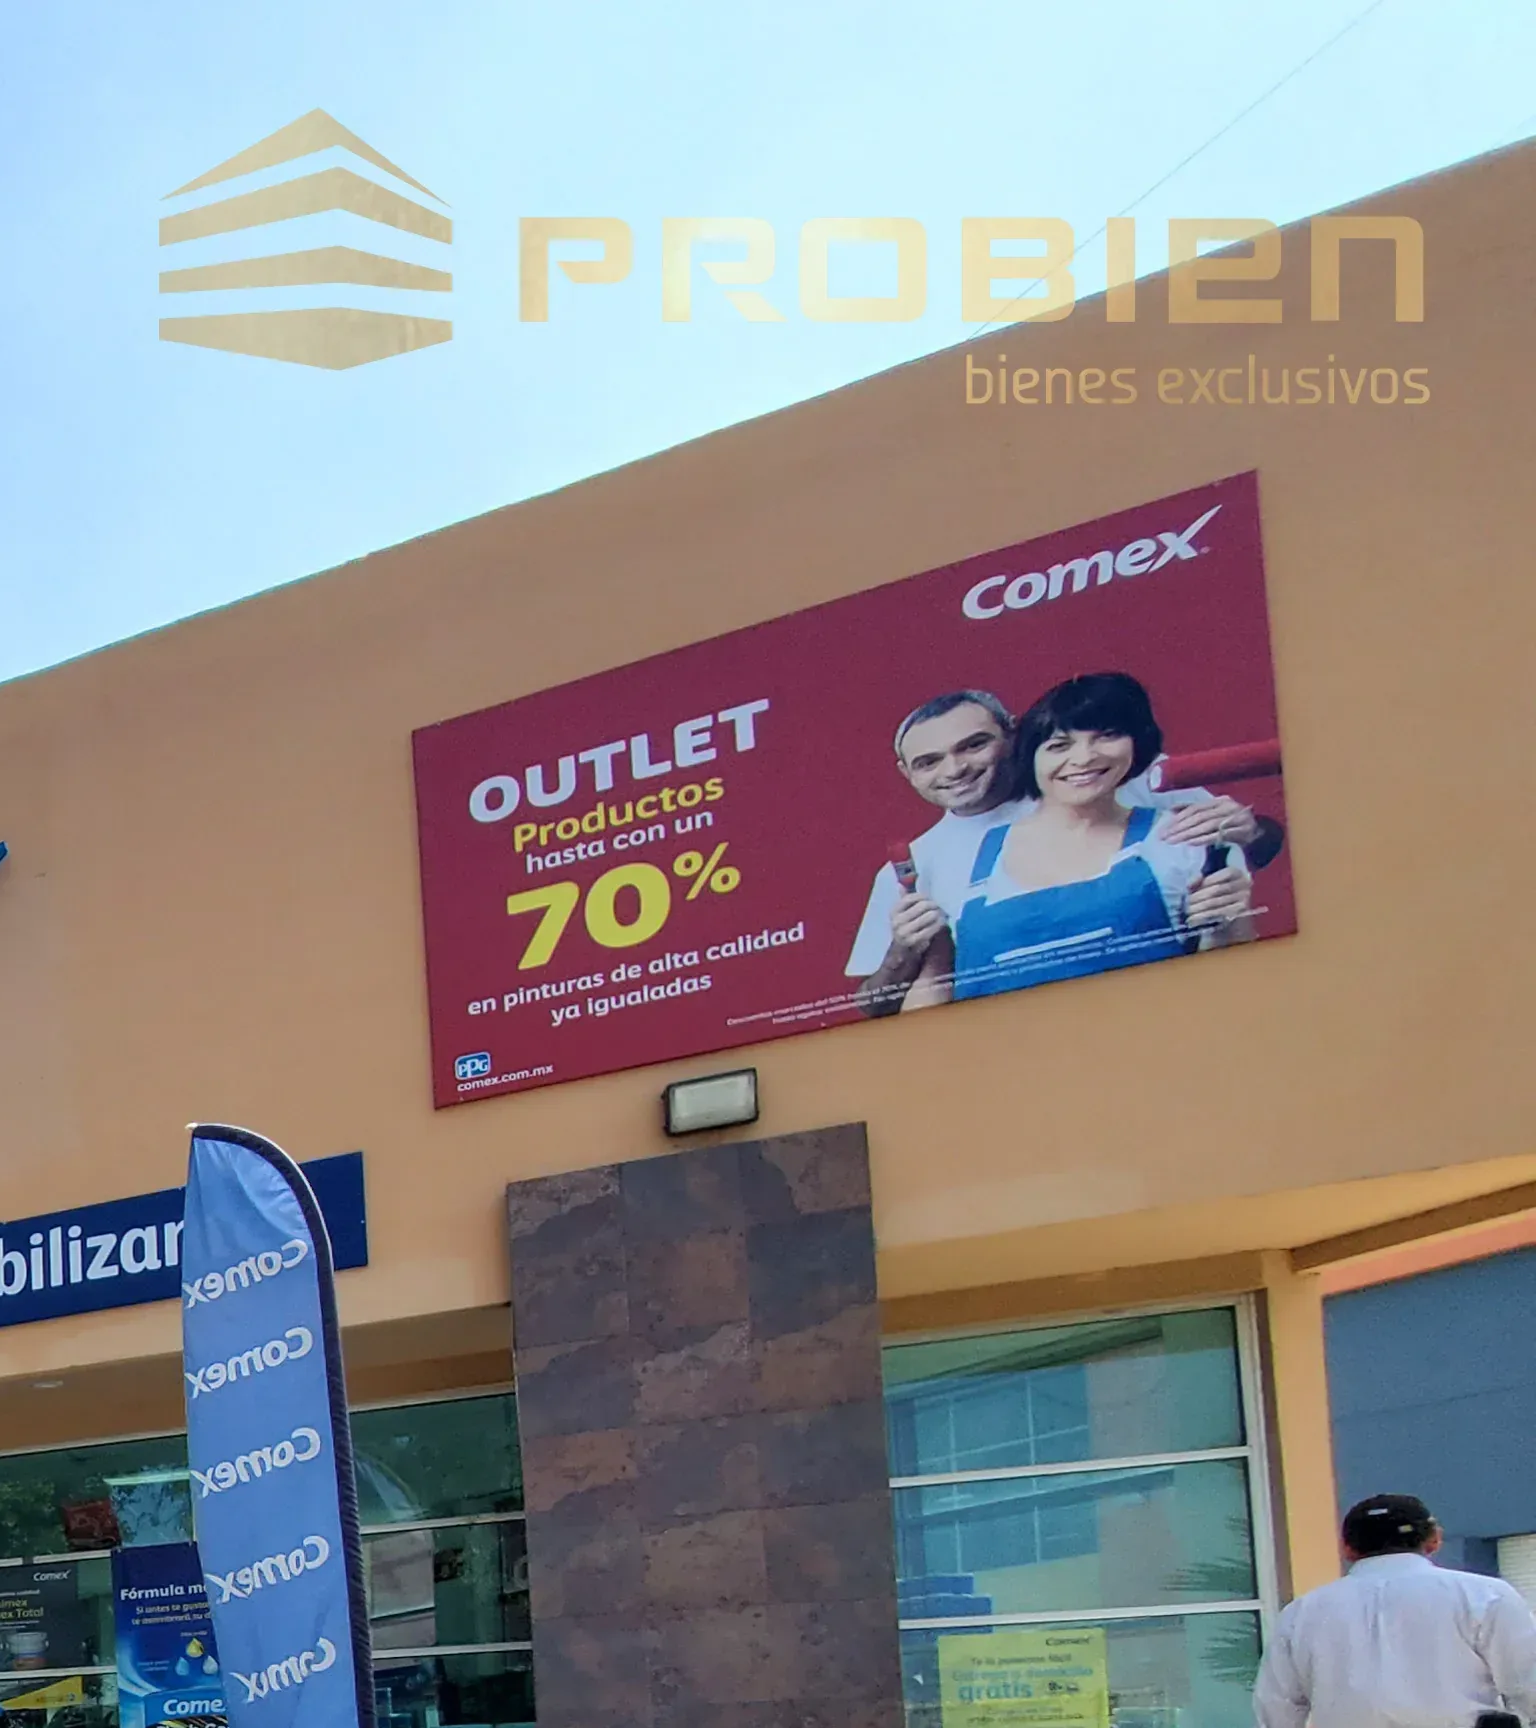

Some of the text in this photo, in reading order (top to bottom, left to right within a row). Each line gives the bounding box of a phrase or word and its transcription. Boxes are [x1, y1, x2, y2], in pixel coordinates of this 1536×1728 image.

[962, 504, 1222, 619] Comex
[469, 698, 769, 823] OUTLET
[513, 777, 724, 852] Productos
[526, 810, 713, 873] hasta con un
[507, 842, 741, 971] 70%
[467, 921, 804, 1015] en pinturas de alta calidad
[550, 972, 713, 1027] ya igualadas
[456, 1056, 490, 1079] PPG
[457, 1064, 554, 1092] comex.com.mx
[33, 1569, 71, 1581] Comex
[120, 1584, 185, 1600] Fórmula
[163, 1699, 227, 1716] Come
[958, 1680, 1033, 1703] gratis
